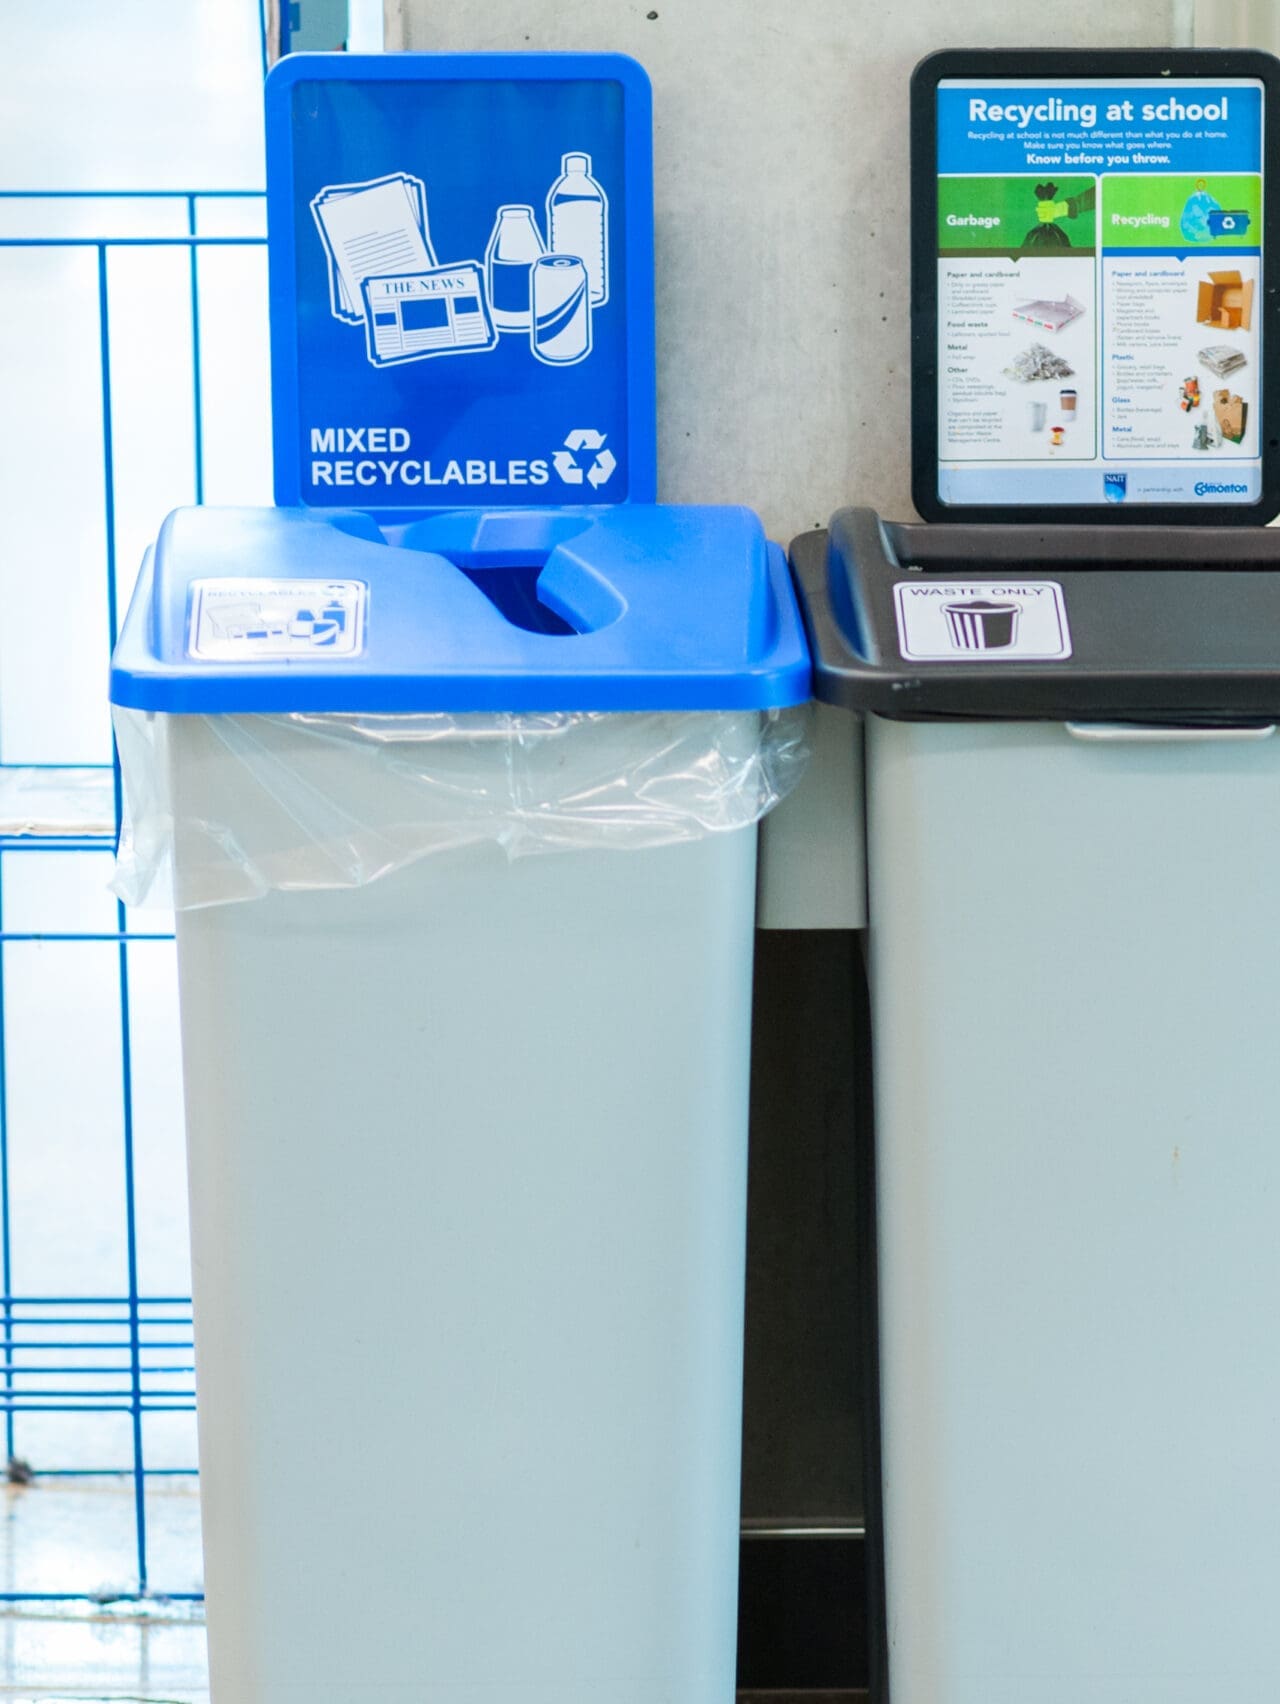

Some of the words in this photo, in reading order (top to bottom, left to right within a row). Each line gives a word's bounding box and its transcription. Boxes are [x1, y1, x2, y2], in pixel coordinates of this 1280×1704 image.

[969, 98, 1097, 128] Recycling
[1106, 101, 1134, 121] at
[1142, 97, 1228, 121] school
[967, 131, 1005, 141] Recycling
[1104, 141, 1124, 149] what
[1026, 154, 1061, 164] Know
[1064, 152, 1104, 164] before
[1107, 156, 1129, 166] you
[1132, 153, 1170, 164] throw.
[946, 214, 1000, 228] Garbage
[1111, 213, 1170, 228] Recycling
[384, 282, 413, 294] THE
[419, 277, 464, 291] NEWS
[311, 428, 410, 452] MIXED
[312, 460, 549, 485] RECYCLABLES
[1194, 482, 1248, 496] Edmonton
[910, 588, 981, 596] WASTE
[992, 588, 1044, 596] ONLY
